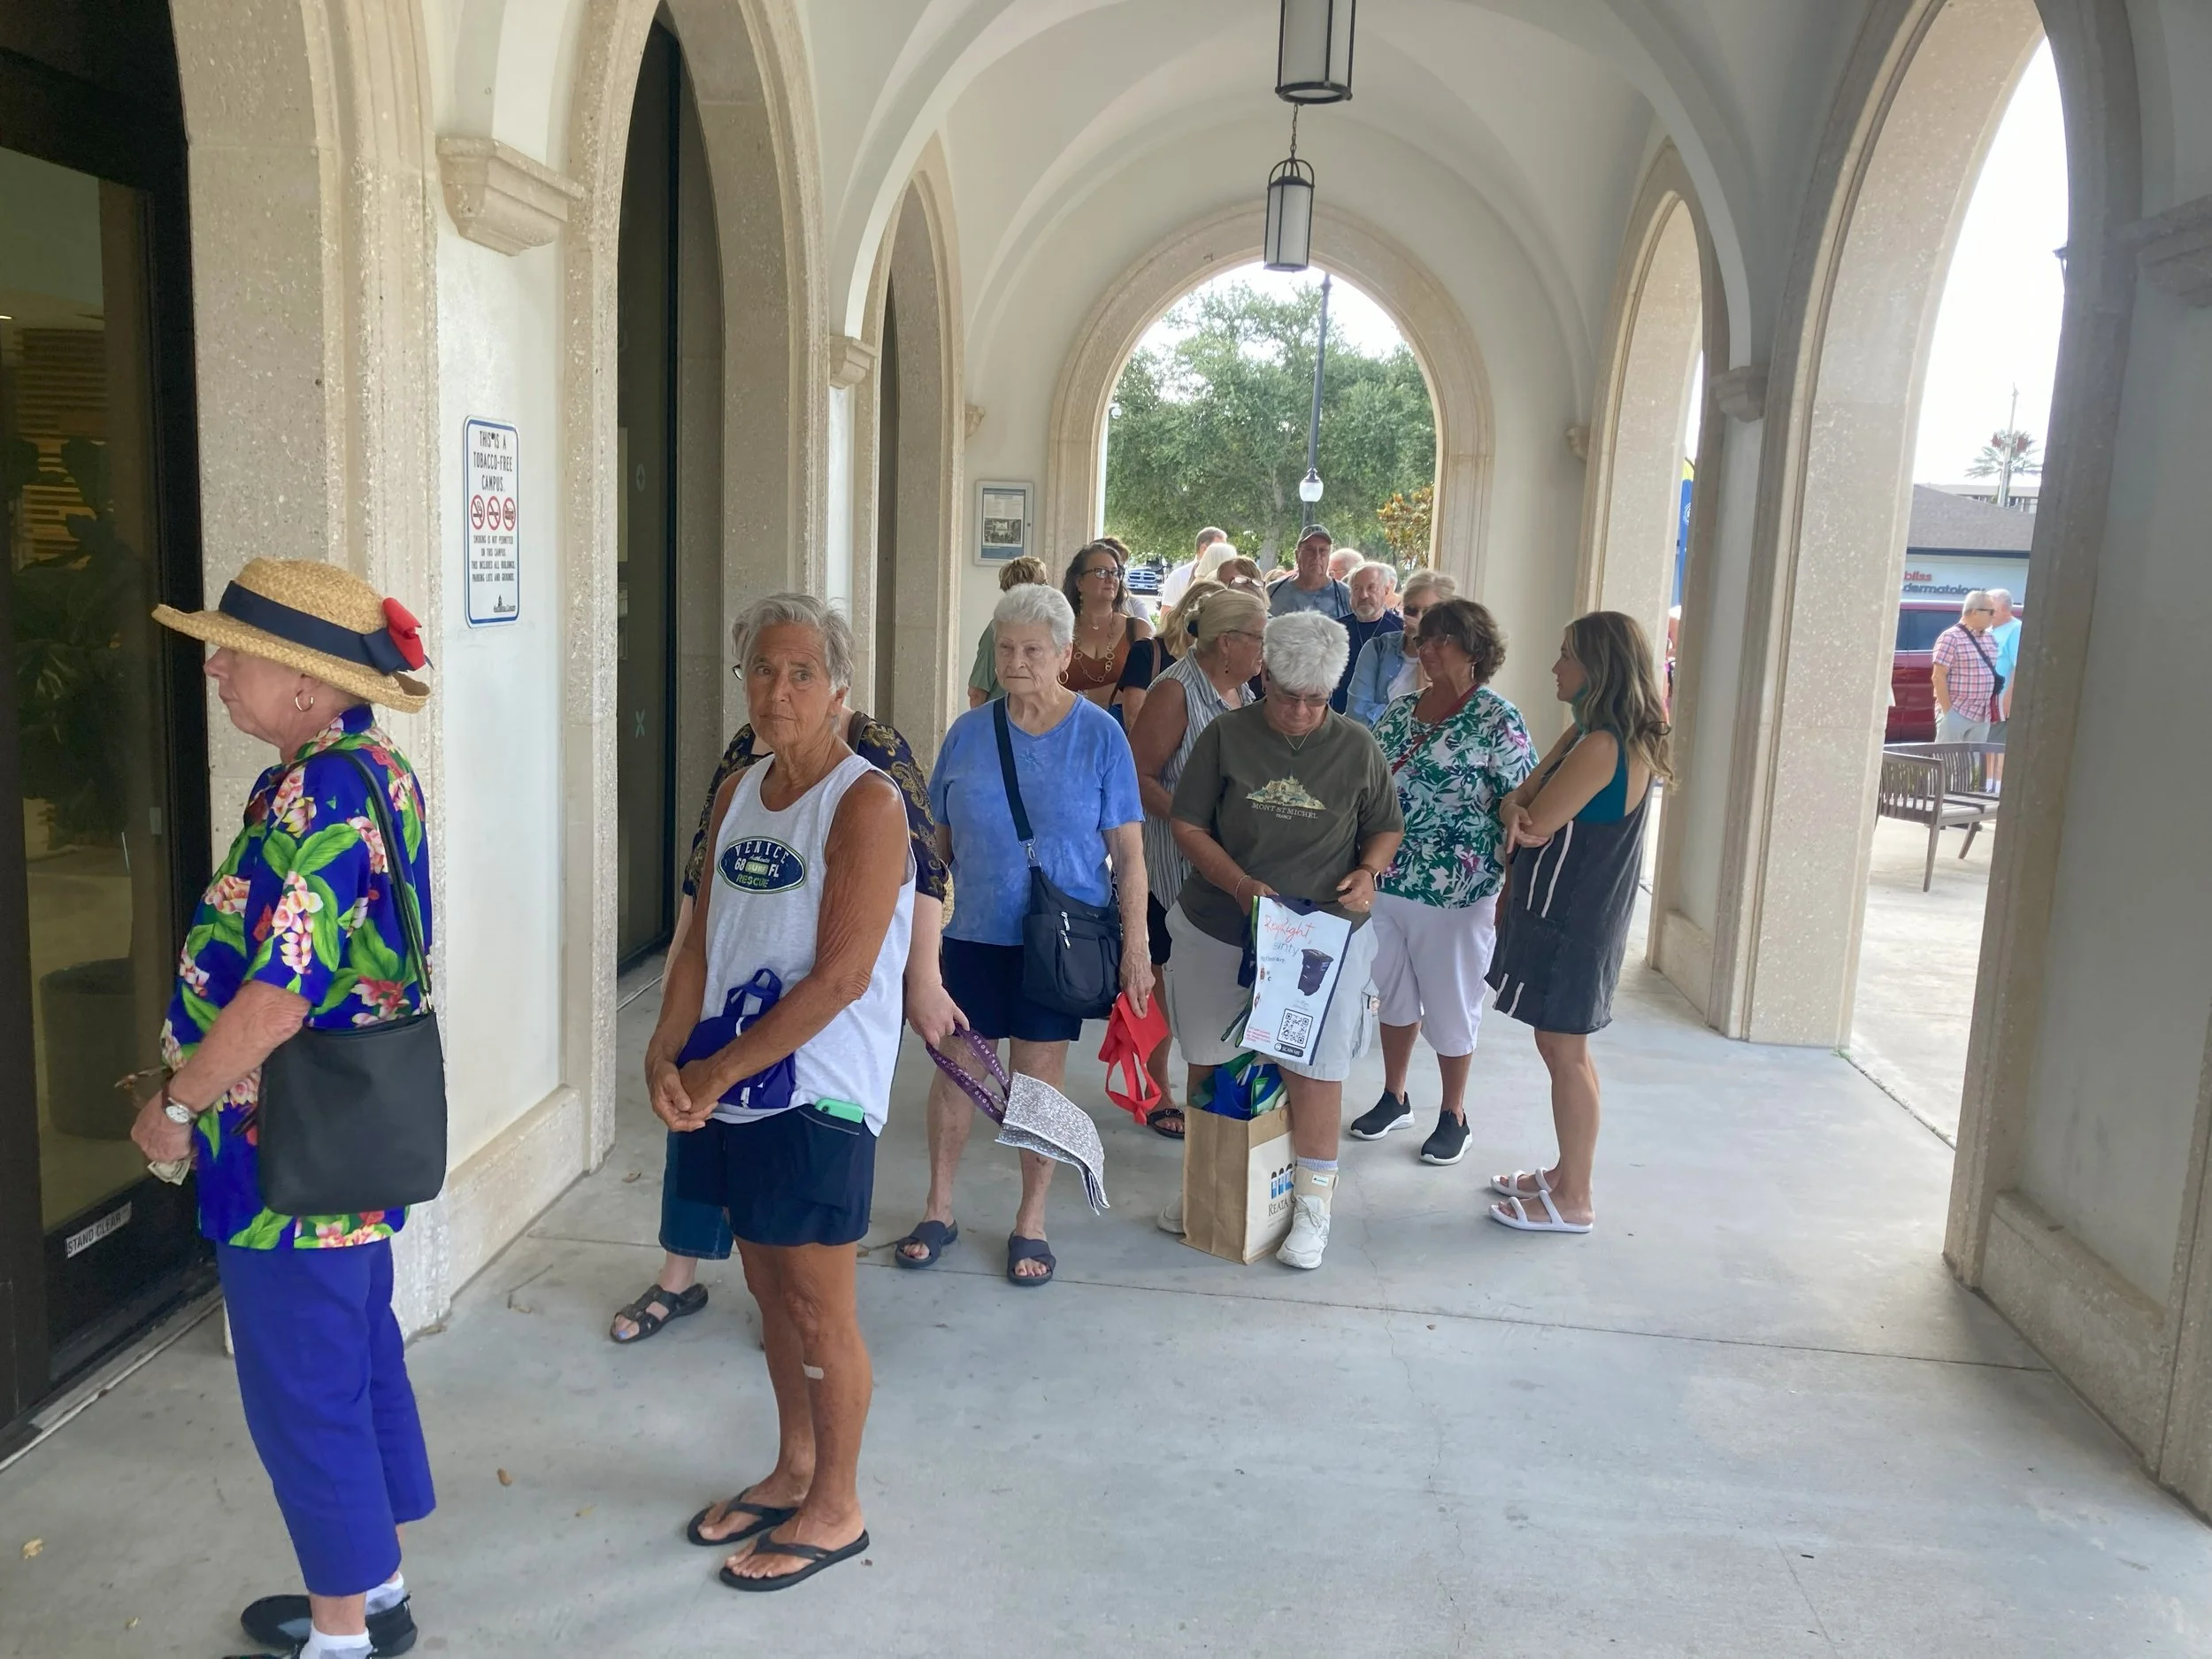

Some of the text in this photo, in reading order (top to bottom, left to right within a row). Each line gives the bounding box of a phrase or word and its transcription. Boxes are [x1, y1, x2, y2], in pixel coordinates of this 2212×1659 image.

[480, 431, 507, 450] THIS IS A
[473, 451, 512, 472] TOBACCO-FREE
[481, 474, 505, 492] CAMPUS.
[1904, 571, 1932, 581] bliss
[1251, 803, 1275, 812] MONT
[1287, 808, 1318, 819] MICHEL
[735, 841, 789, 864] VENICE
[734, 857, 780, 878] 68 SURF FL
[736, 874, 769, 887] RESCUE
[973, 1034, 990, 1055] GROW
[974, 1090, 995, 1113] BLOOM
[1268, 1199, 1288, 1217] REATA
[67, 1211, 121, 1254] STAND CLEAR
